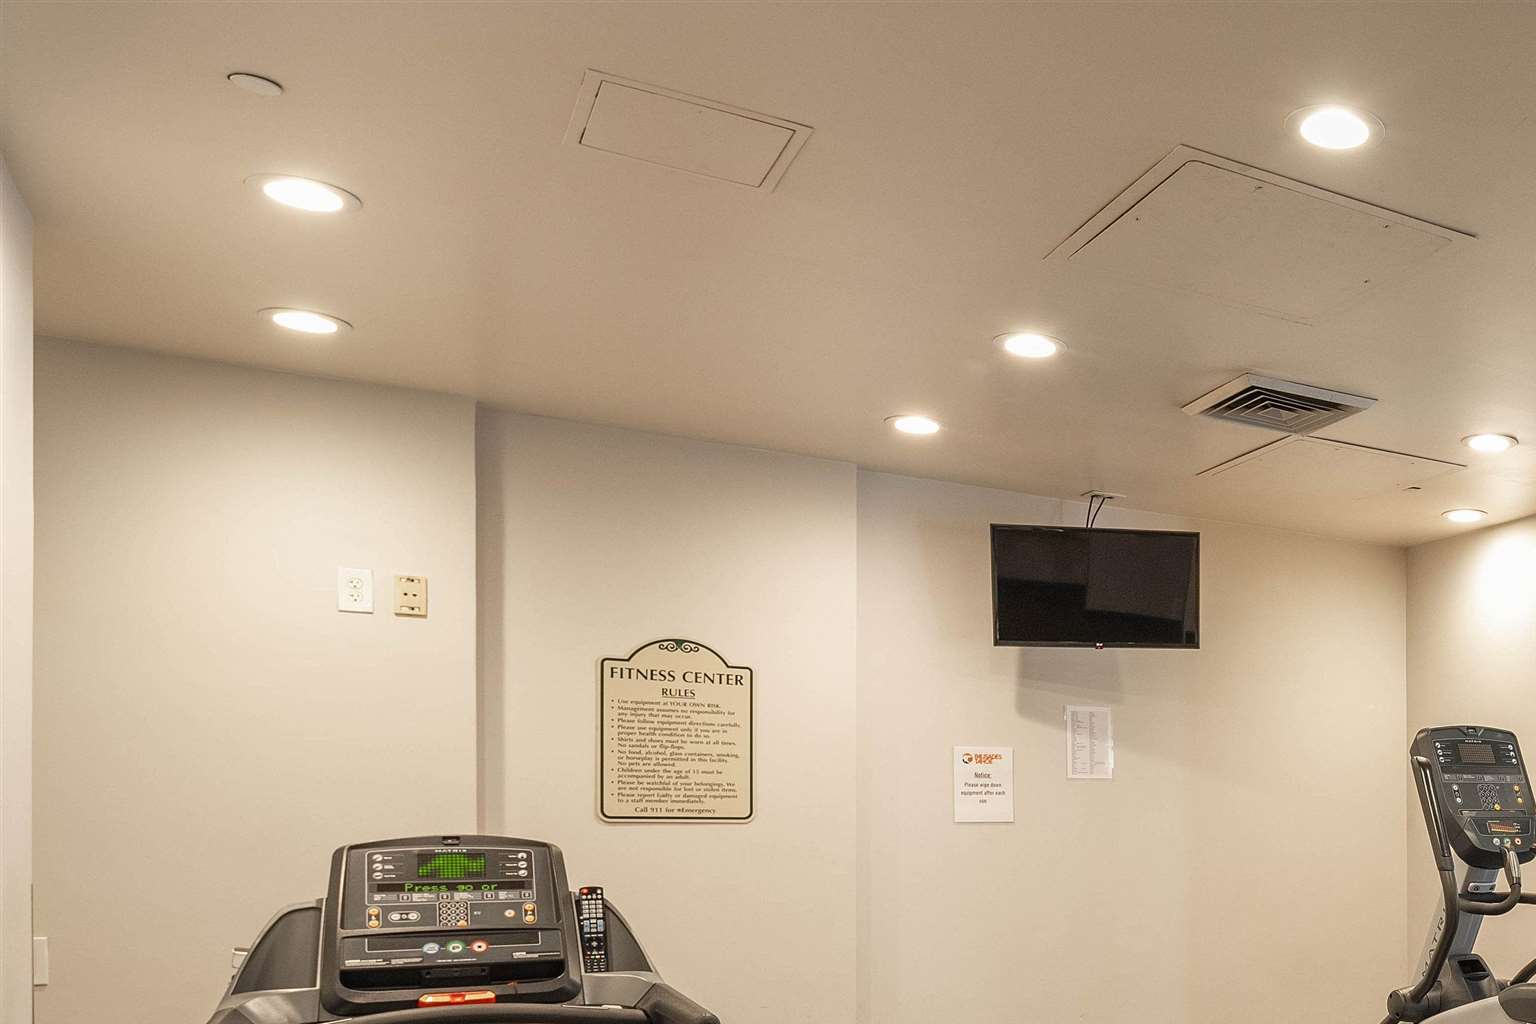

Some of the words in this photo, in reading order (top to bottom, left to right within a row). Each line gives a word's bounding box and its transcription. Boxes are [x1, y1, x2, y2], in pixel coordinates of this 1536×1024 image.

[610, 667, 675, 682] FITNESS
[683, 671, 744, 686] CENTER
[661, 687, 696, 697] RULES
[404, 883, 449, 892] Press
[481, 883, 498, 891] or
